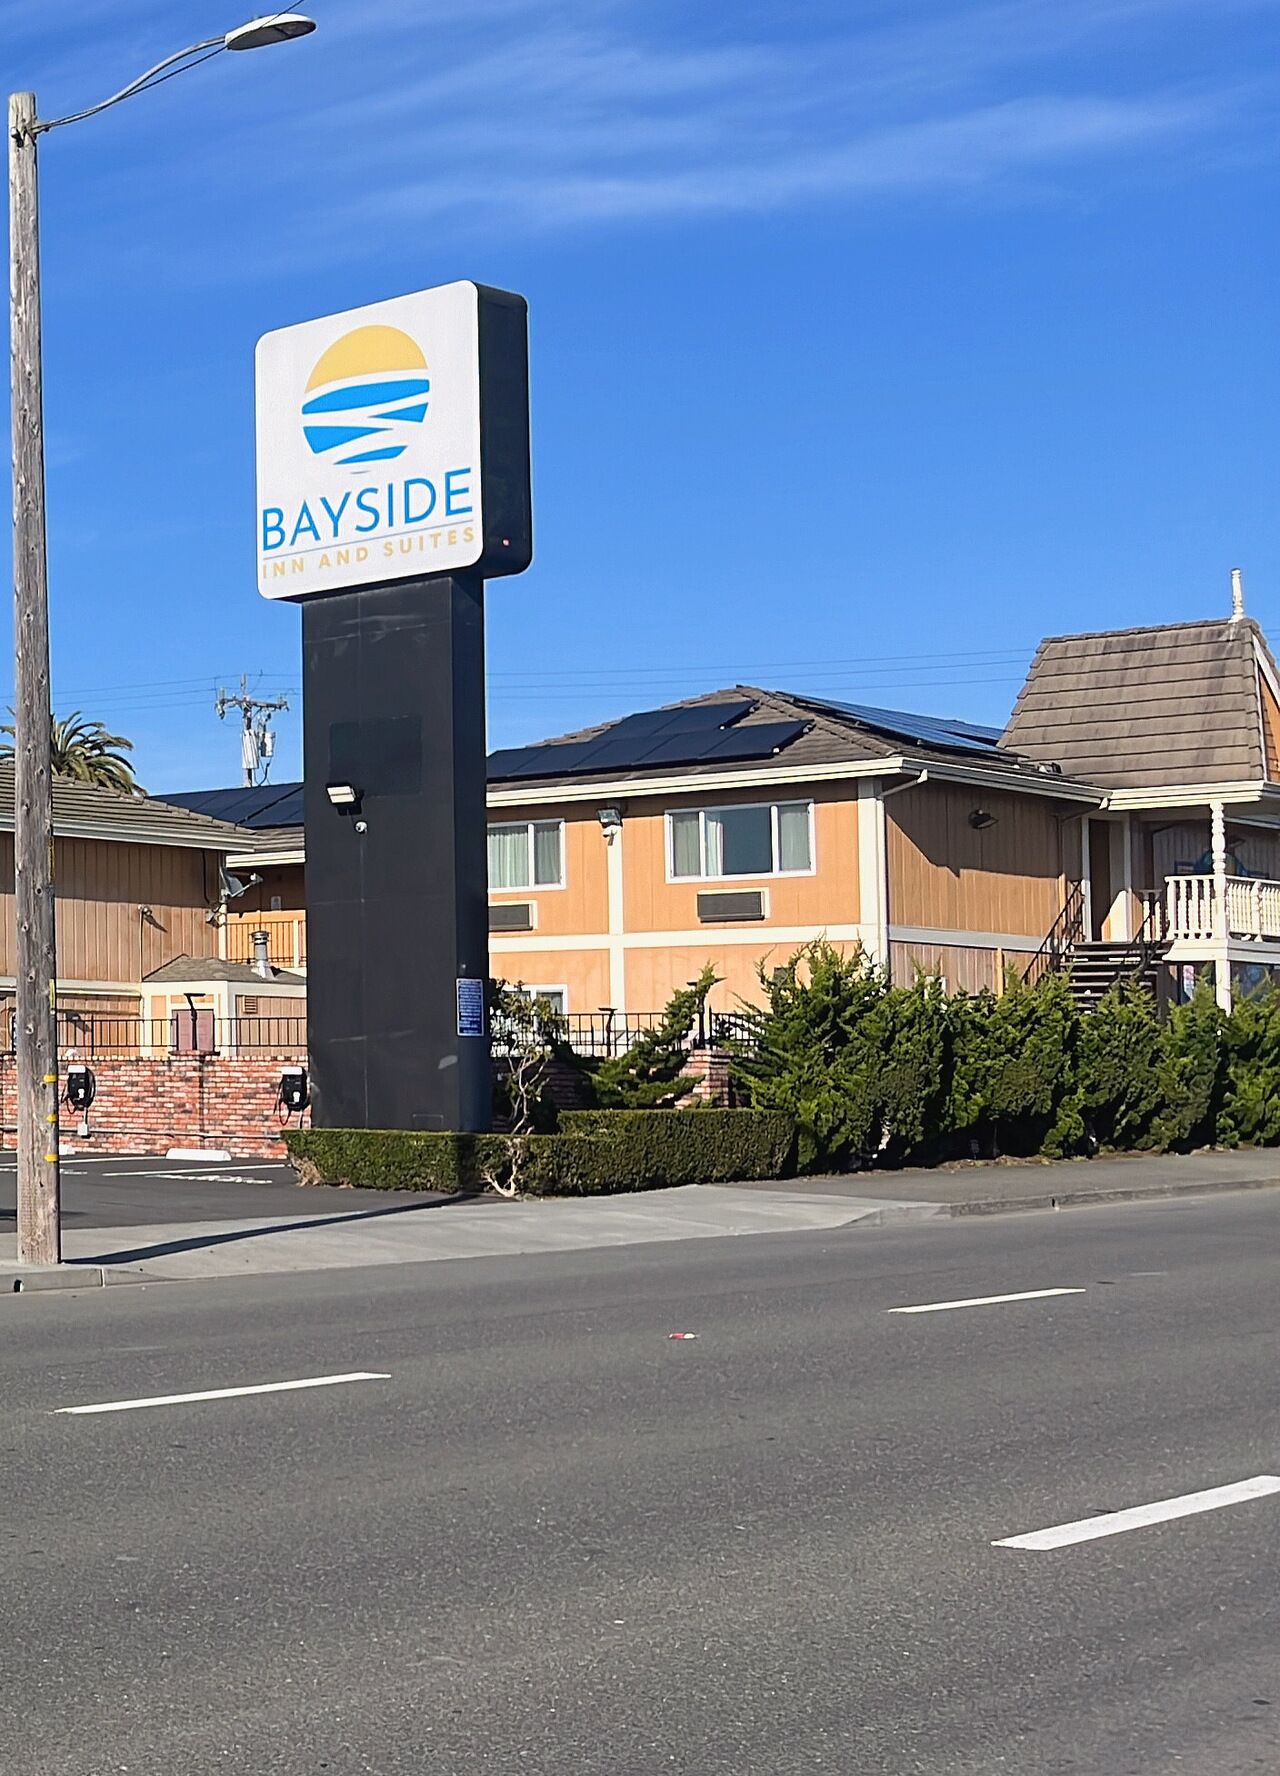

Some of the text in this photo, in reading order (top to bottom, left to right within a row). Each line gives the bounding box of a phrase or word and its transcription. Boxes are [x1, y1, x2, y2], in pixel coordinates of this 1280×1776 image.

[262, 468, 473, 551] BAYSIDE
[262, 527, 475, 579] INN AND SUITES
